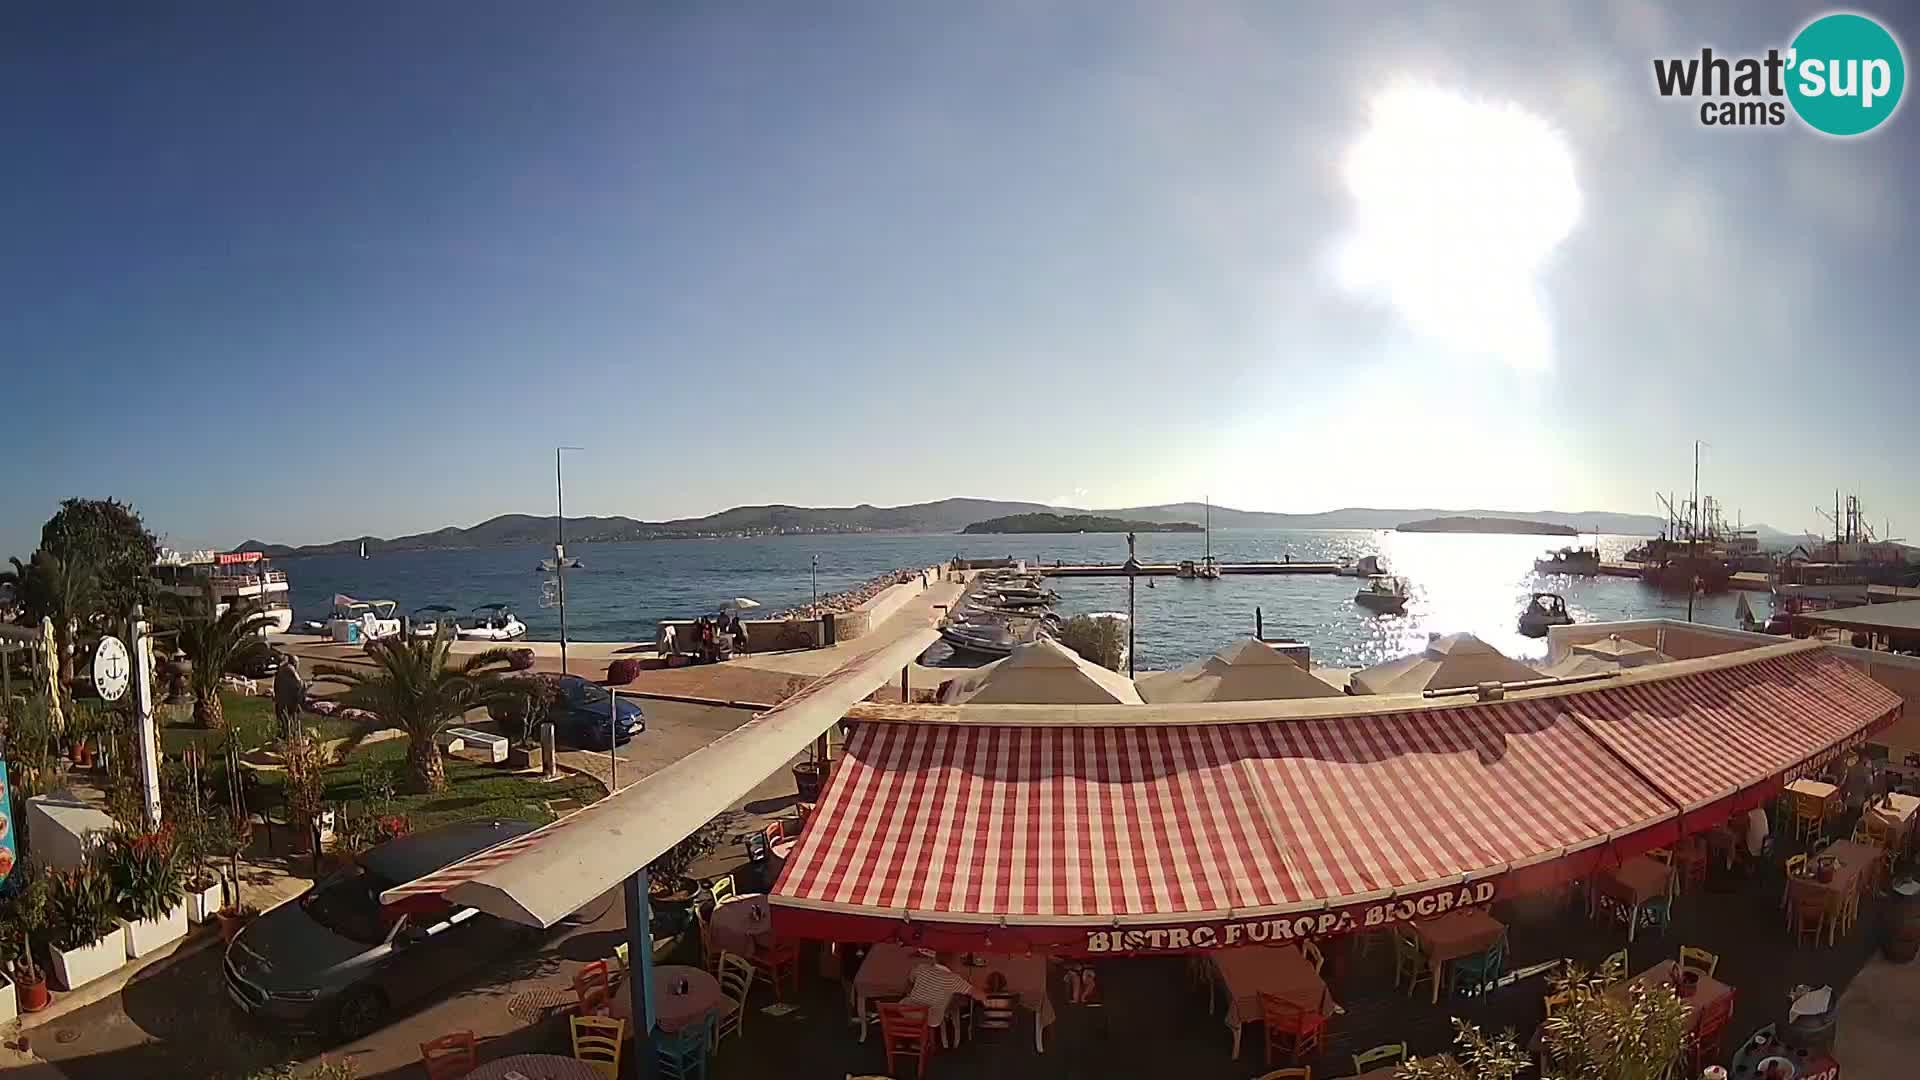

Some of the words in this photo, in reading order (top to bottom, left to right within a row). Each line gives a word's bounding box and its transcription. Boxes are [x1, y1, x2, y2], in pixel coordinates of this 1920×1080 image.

[1086, 926, 1218, 953] BISTRO
[1223, 911, 1359, 945] EUROPA
[1363, 881, 1495, 927] BIOGRAD
